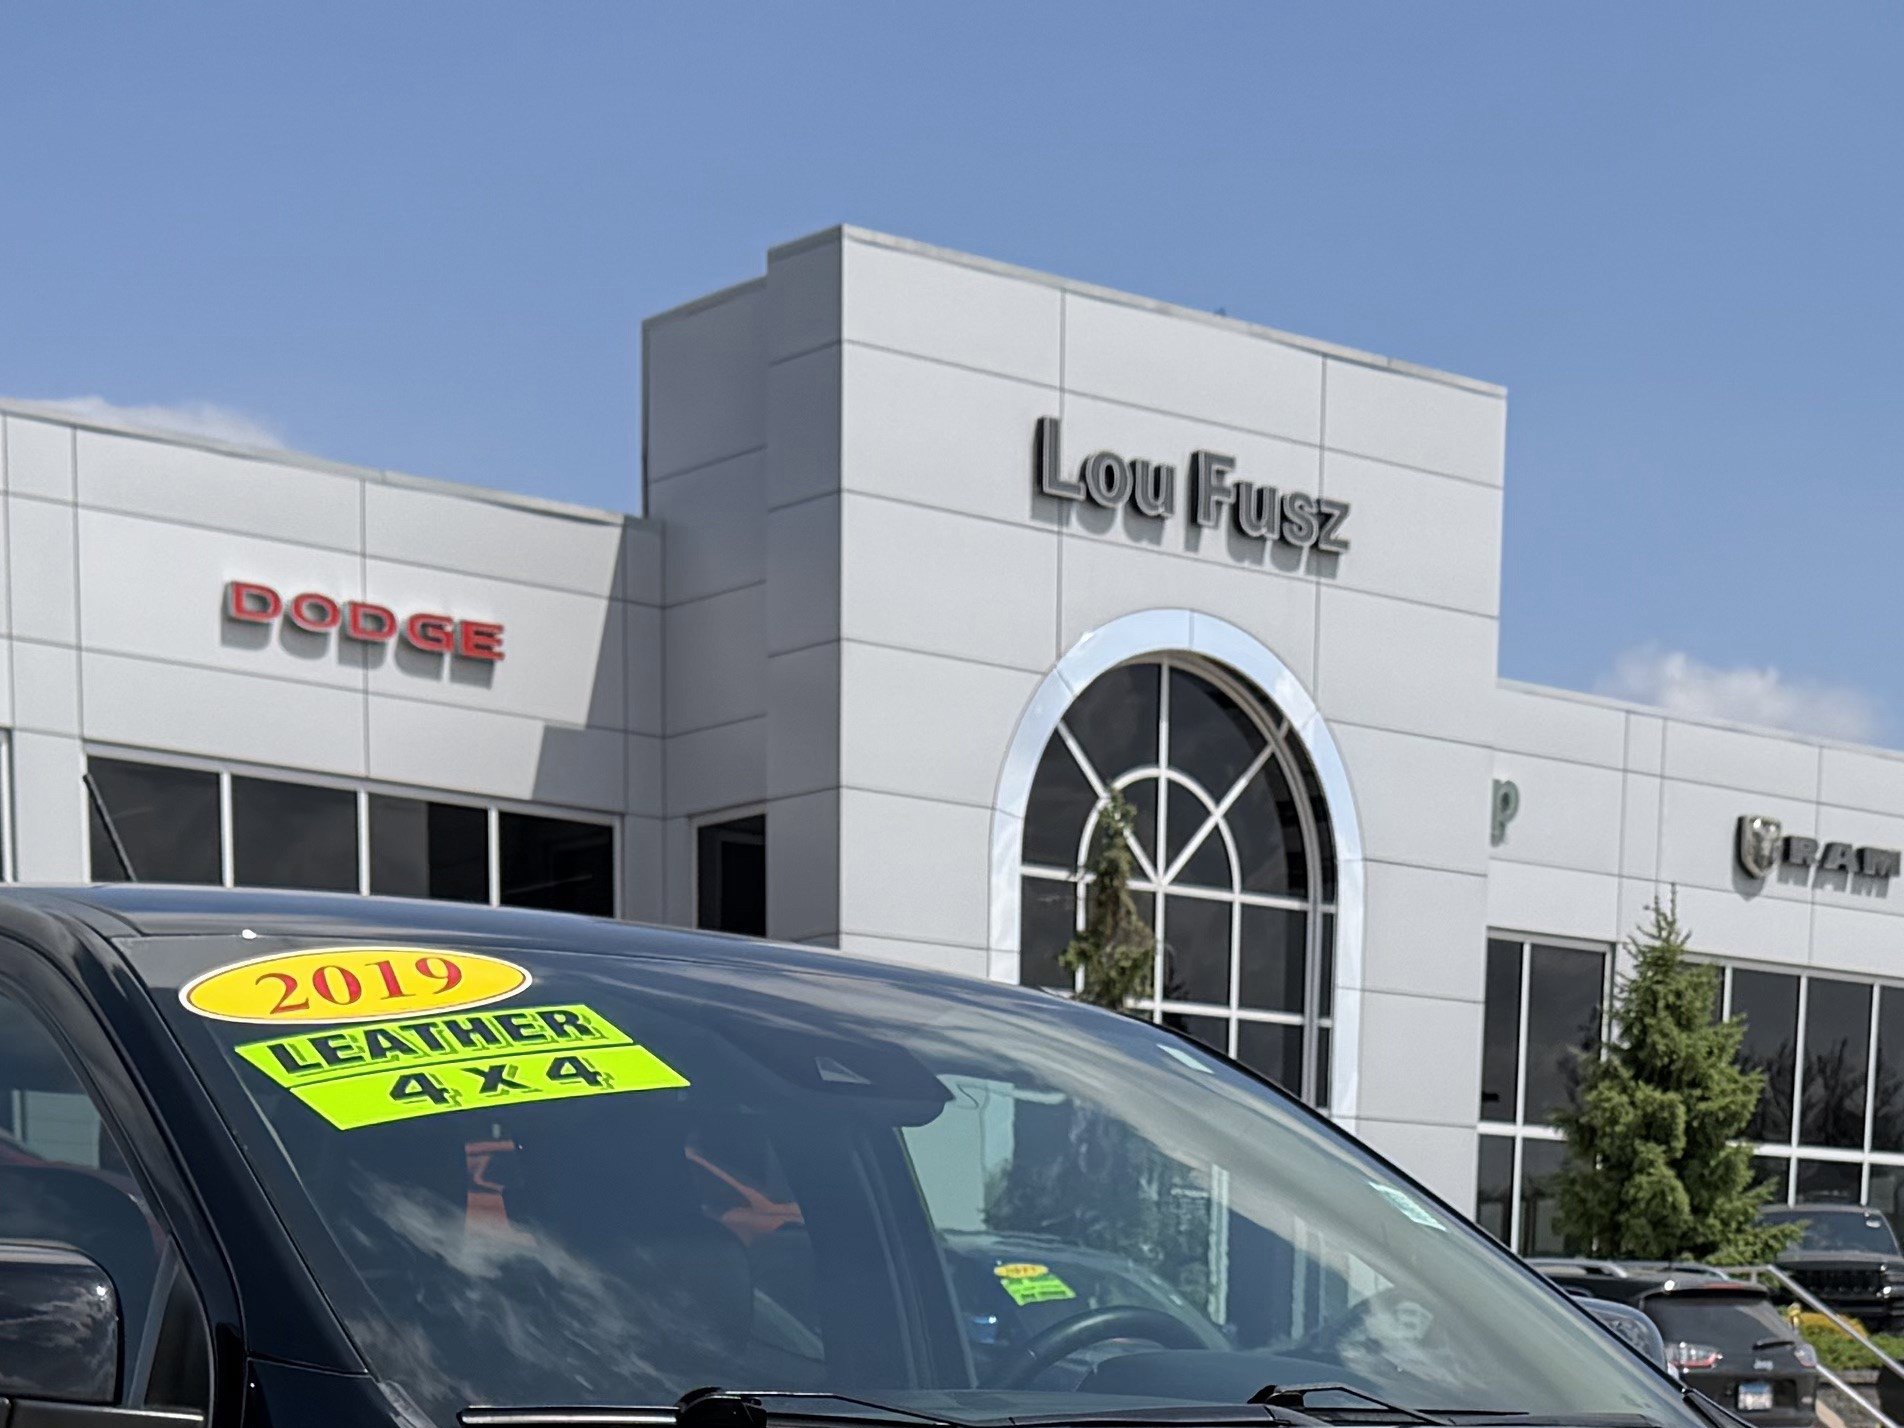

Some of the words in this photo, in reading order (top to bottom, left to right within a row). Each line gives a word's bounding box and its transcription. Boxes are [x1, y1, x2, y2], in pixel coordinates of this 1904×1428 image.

[1034, 416, 1175, 517] Lou
[1189, 449, 1350, 553] Fusz
[222, 580, 505, 661] DODGE
[1782, 836, 1901, 878] RAM
[255, 956, 463, 1014] 2019
[266, 1009, 598, 1075] LEATHER
